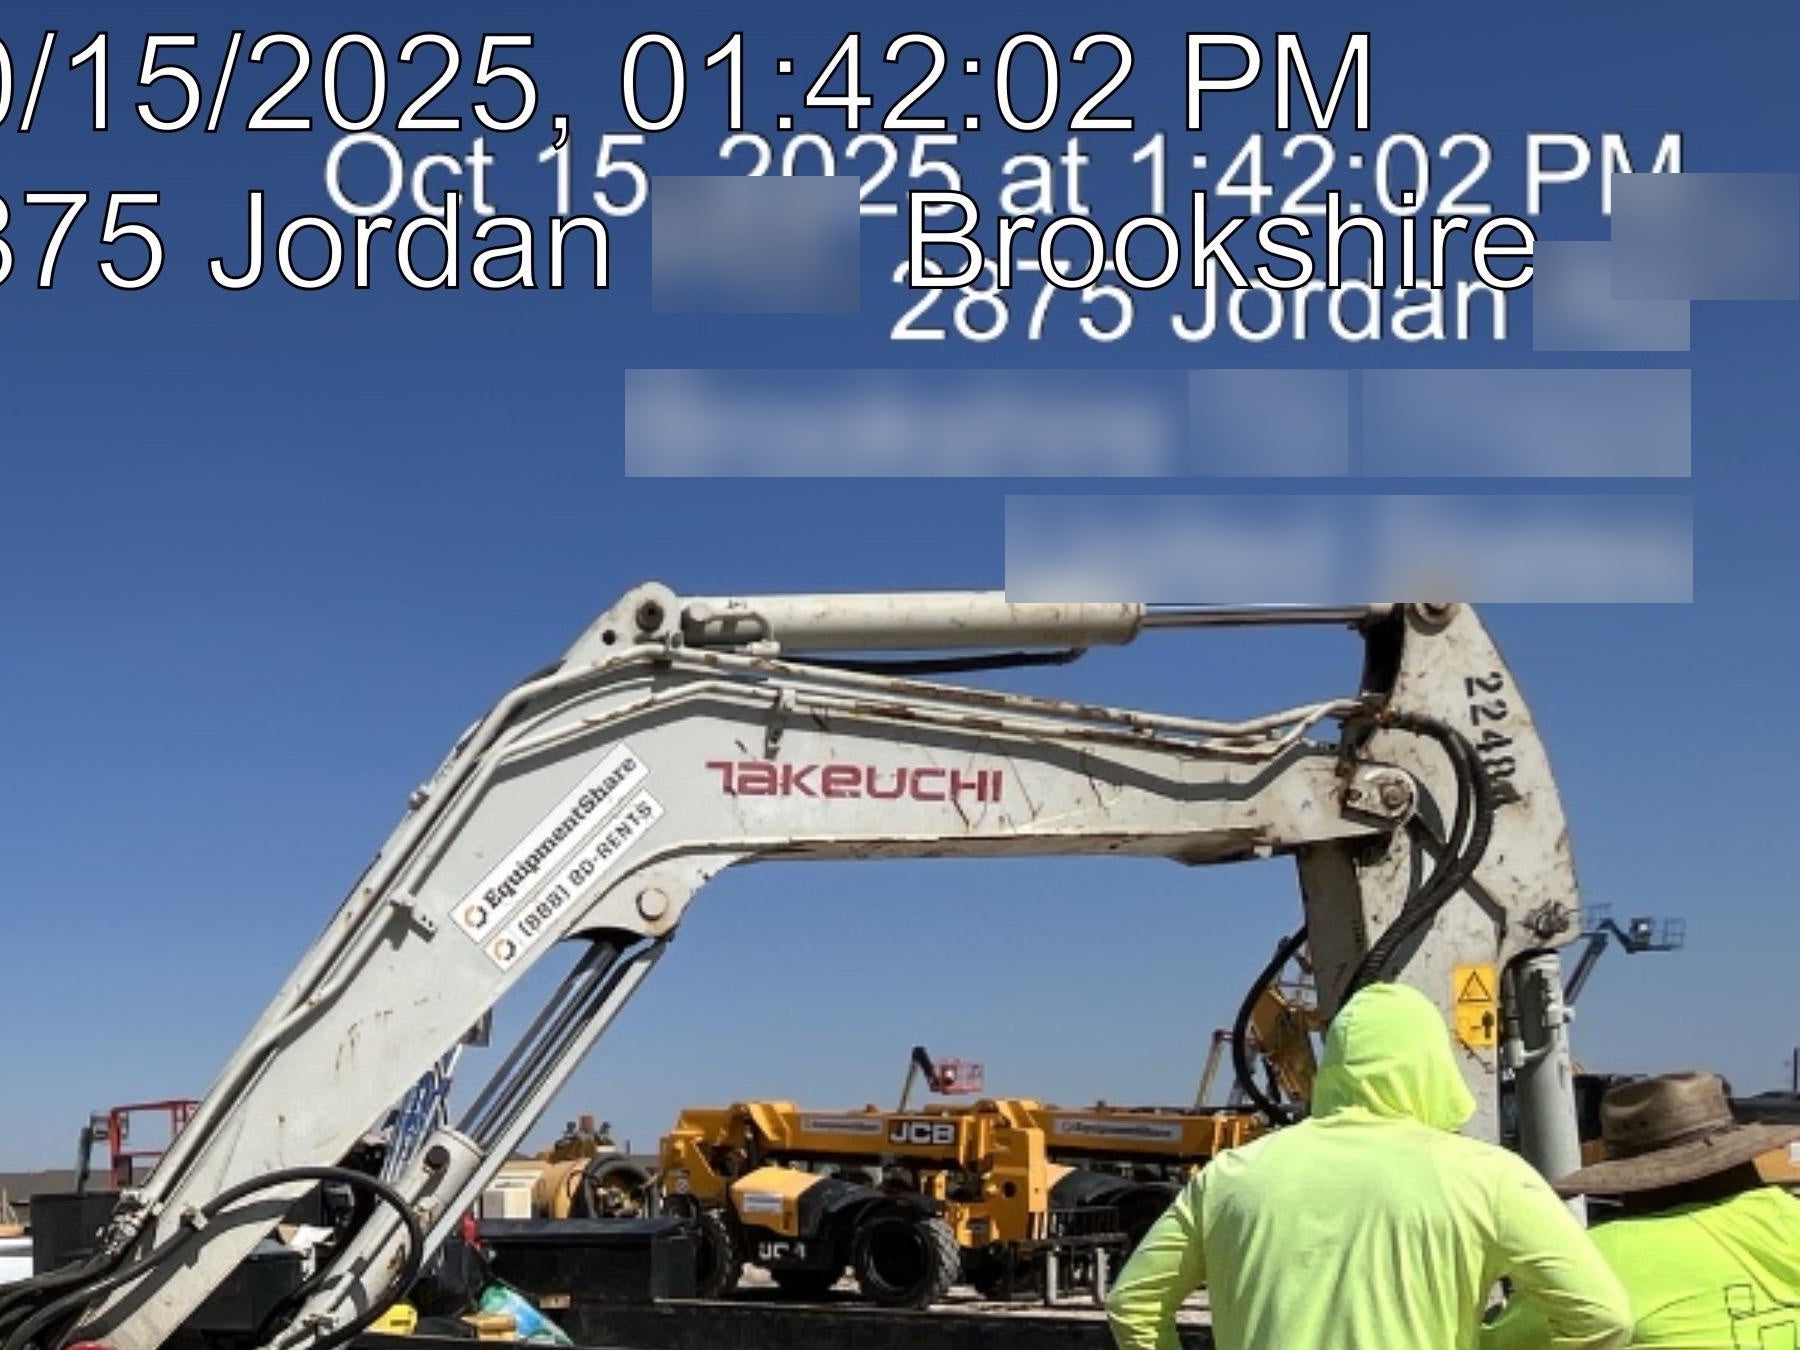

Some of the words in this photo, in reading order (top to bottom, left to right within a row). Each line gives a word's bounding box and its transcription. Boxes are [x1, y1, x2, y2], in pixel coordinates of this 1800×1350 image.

[706, 761, 1003, 803] TAKEUCHI
[482, 757, 637, 910] EquipmentShare
[890, 1121, 955, 1145] JCB
